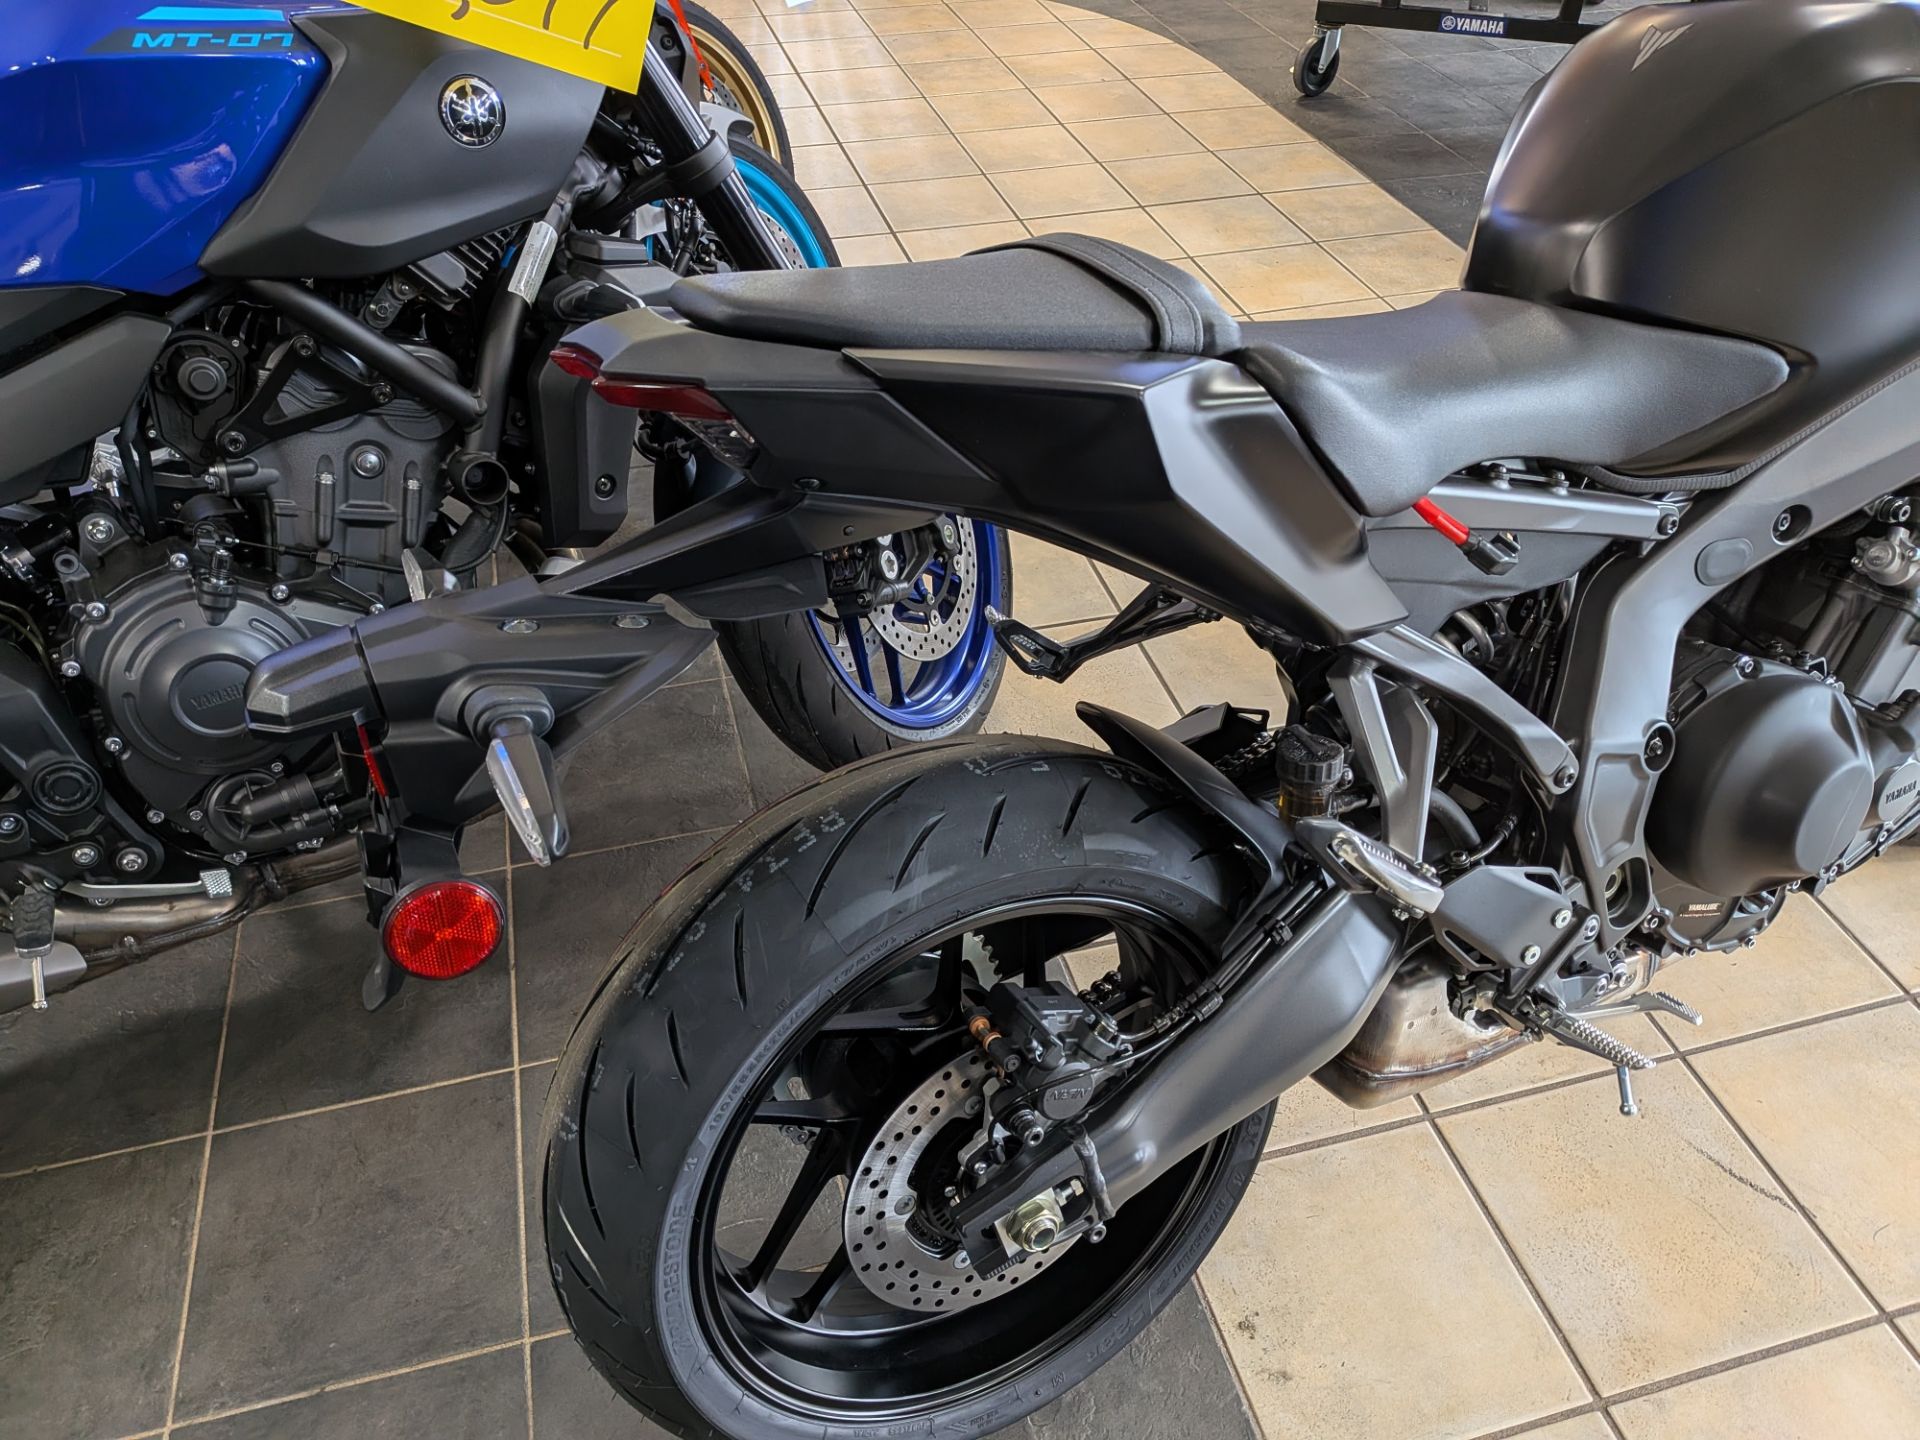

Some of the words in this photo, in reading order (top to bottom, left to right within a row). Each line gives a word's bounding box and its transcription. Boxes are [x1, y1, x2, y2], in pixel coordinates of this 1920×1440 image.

[1456, 17, 1505, 34] YAMAHA
[132, 32, 294, 48] MT-07
[190, 681, 247, 710] YAMAH
